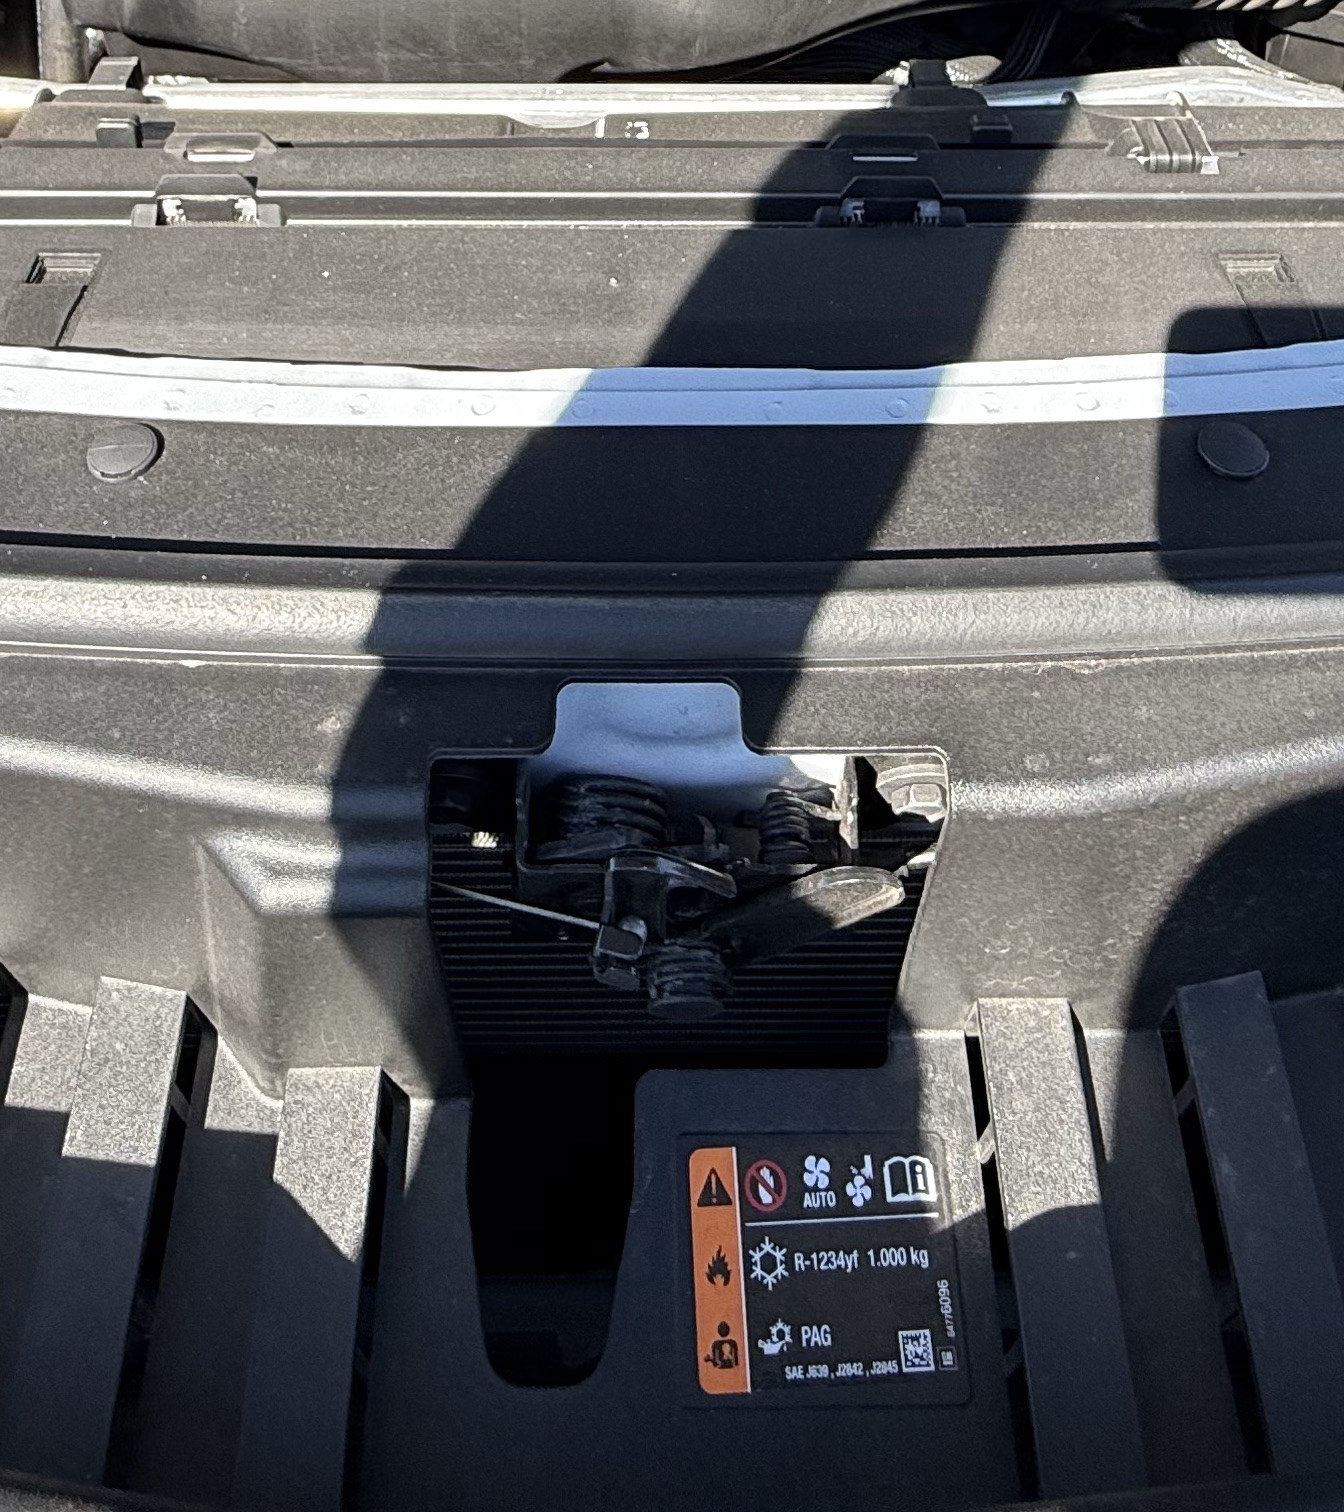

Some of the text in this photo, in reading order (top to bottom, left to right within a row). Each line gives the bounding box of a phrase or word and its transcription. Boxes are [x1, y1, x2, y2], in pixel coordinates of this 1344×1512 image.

[803, 1190, 837, 1208] AUTO
[794, 1246, 929, 1273] R-1234yf 1.000 kg
[800, 1324, 833, 1347] PAG
[784, 1365, 805, 1380] SAE
